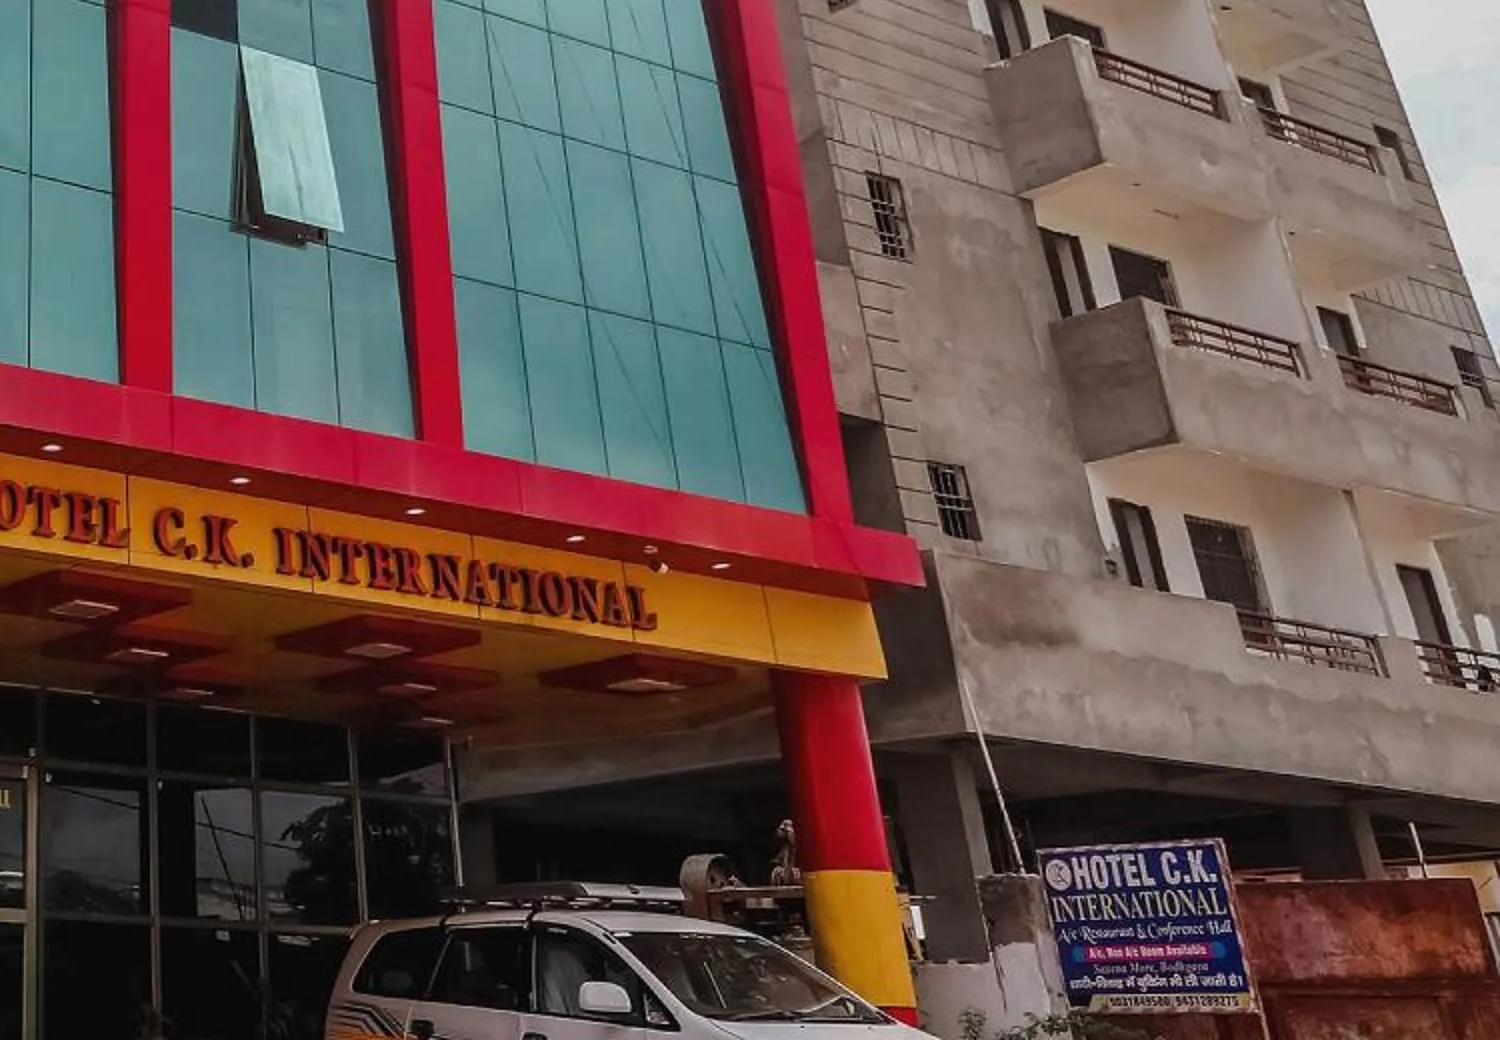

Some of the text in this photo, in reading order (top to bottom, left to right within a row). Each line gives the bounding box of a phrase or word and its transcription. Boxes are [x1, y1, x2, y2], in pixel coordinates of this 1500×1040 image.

[152, 508, 254, 570] C.K.
[274, 527, 658, 630] INTERNATIONAL
[1071, 849, 1218, 891] HOTEL C.K.
[1052, 887, 1227, 922] INTERNATIONAL
[1147, 921, 1205, 941] Conference
[1207, 919, 1233, 936] Hall
